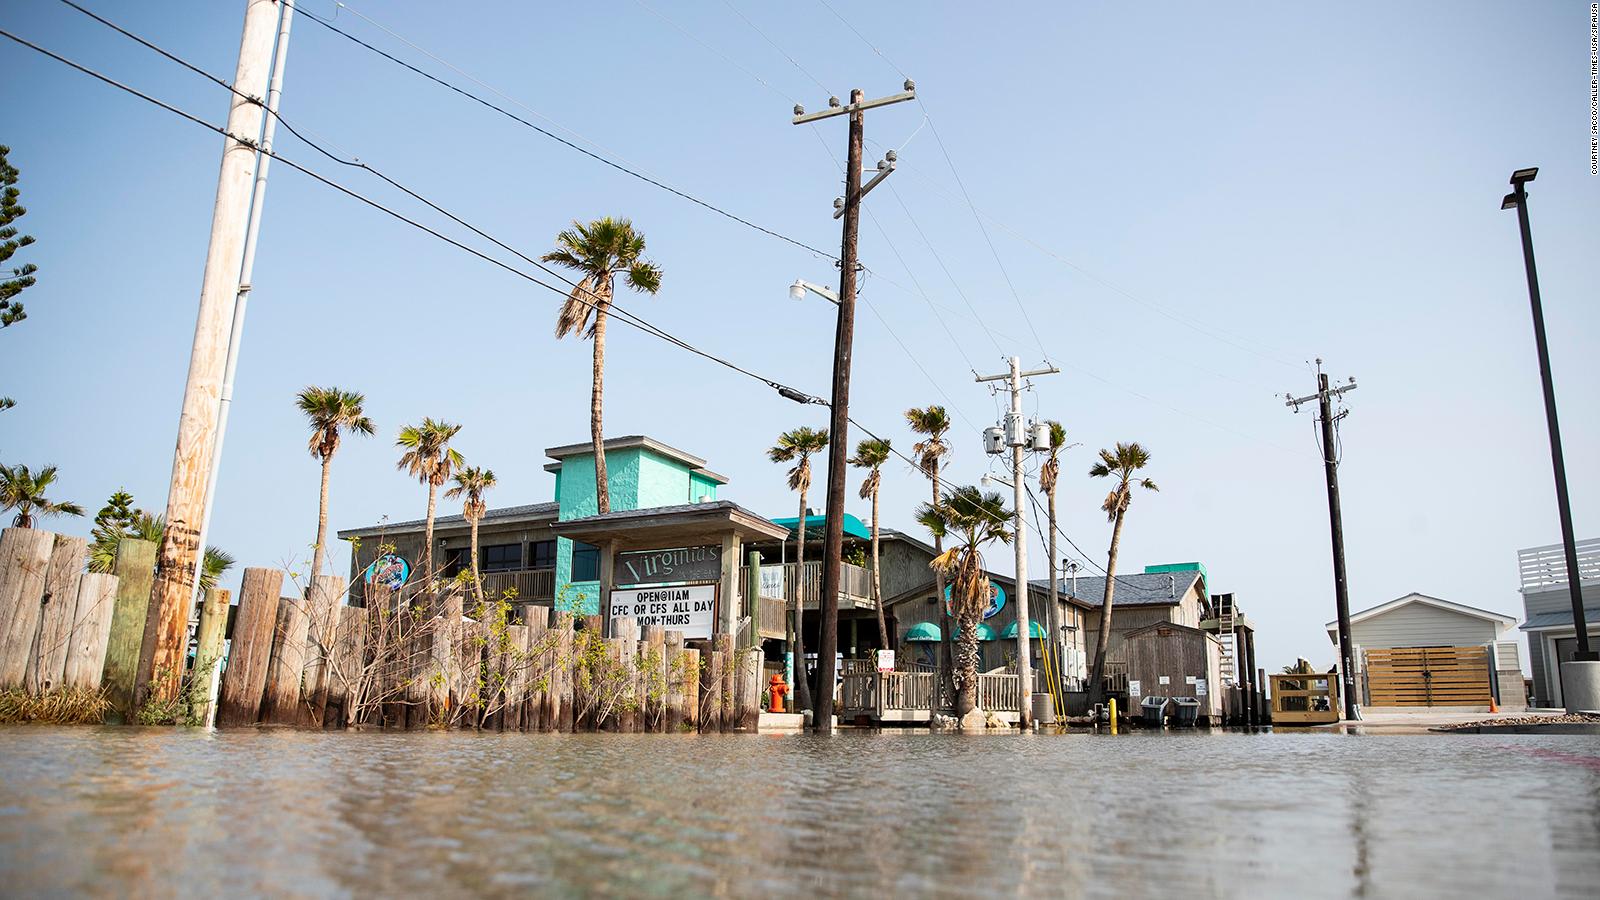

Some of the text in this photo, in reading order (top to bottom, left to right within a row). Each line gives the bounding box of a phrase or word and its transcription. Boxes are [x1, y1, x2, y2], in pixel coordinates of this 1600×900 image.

[625, 547, 717, 582] Virginia's
[612, 600, 714, 616] CFC OR CFS ALL DAY
[636, 614, 690, 626] MON-THURS
